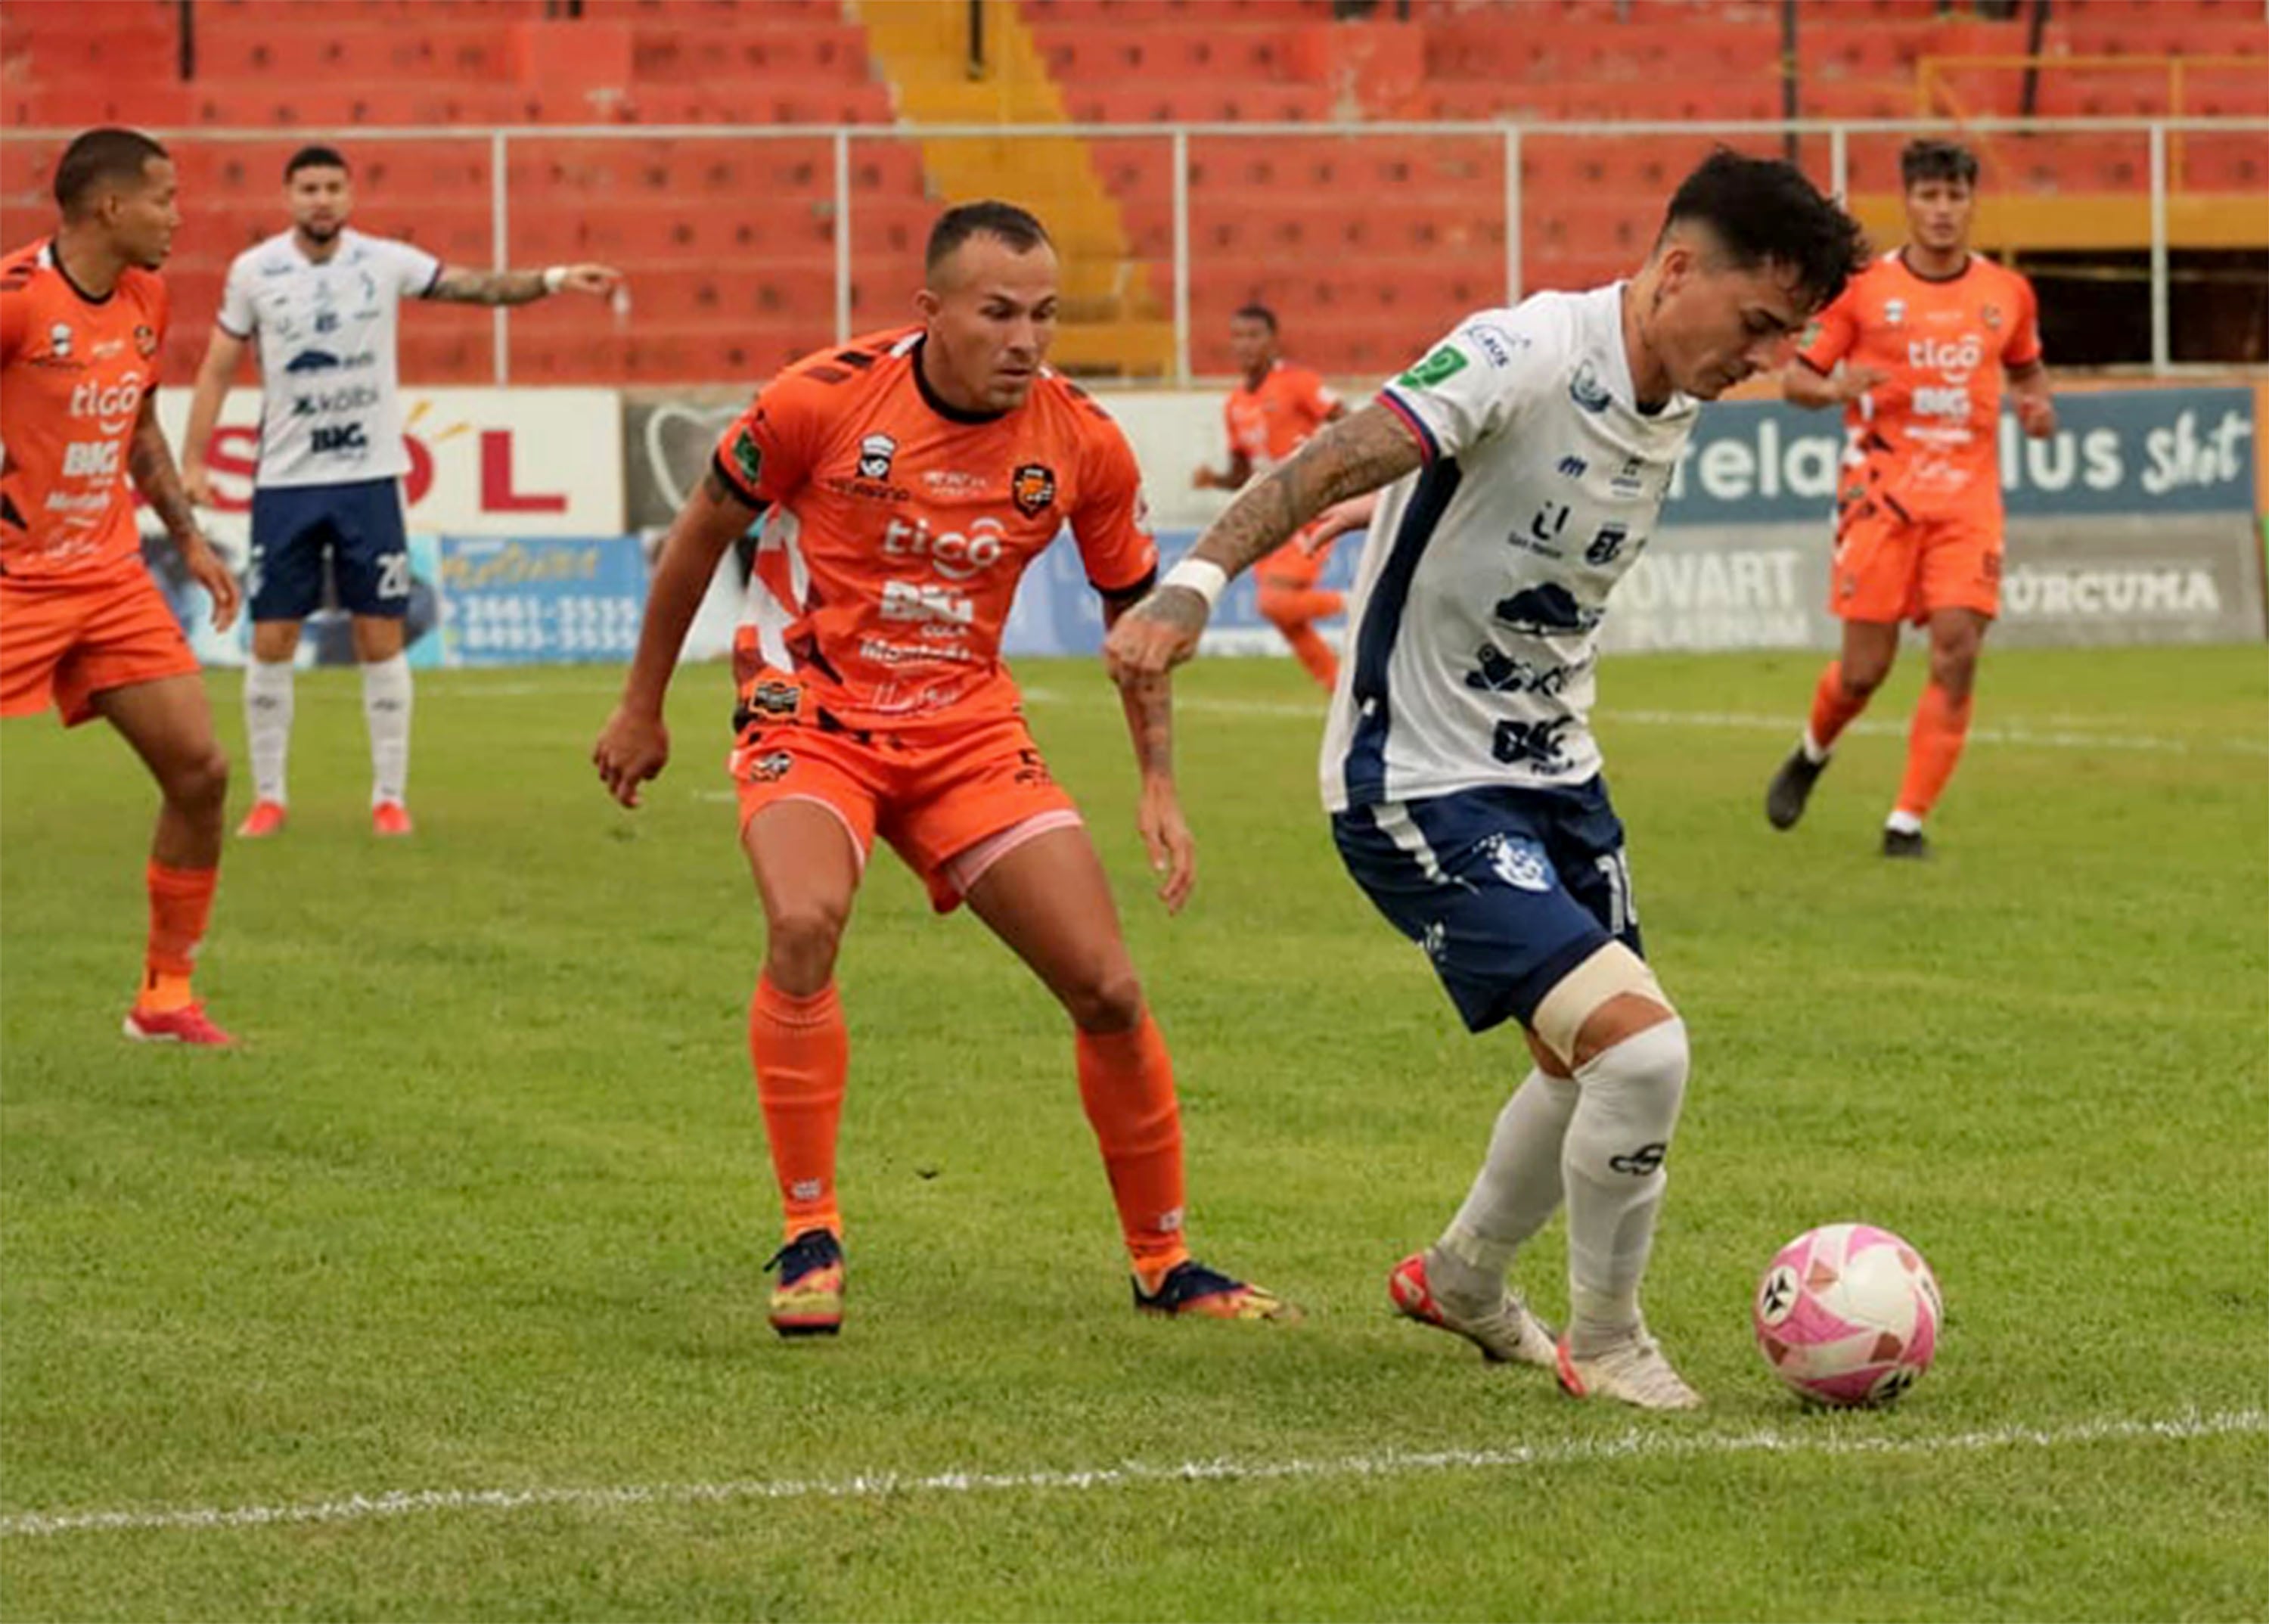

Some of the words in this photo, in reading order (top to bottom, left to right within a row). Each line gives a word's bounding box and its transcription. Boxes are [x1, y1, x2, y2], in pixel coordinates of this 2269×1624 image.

[70, 371, 142, 433] tigo
[312, 422, 368, 453] BIG
[1668, 418, 1838, 499] rela
[2000, 412, 2125, 490] lus
[883, 517, 1007, 580] tigo
[2001, 564, 2221, 614] ÚRCUMA
